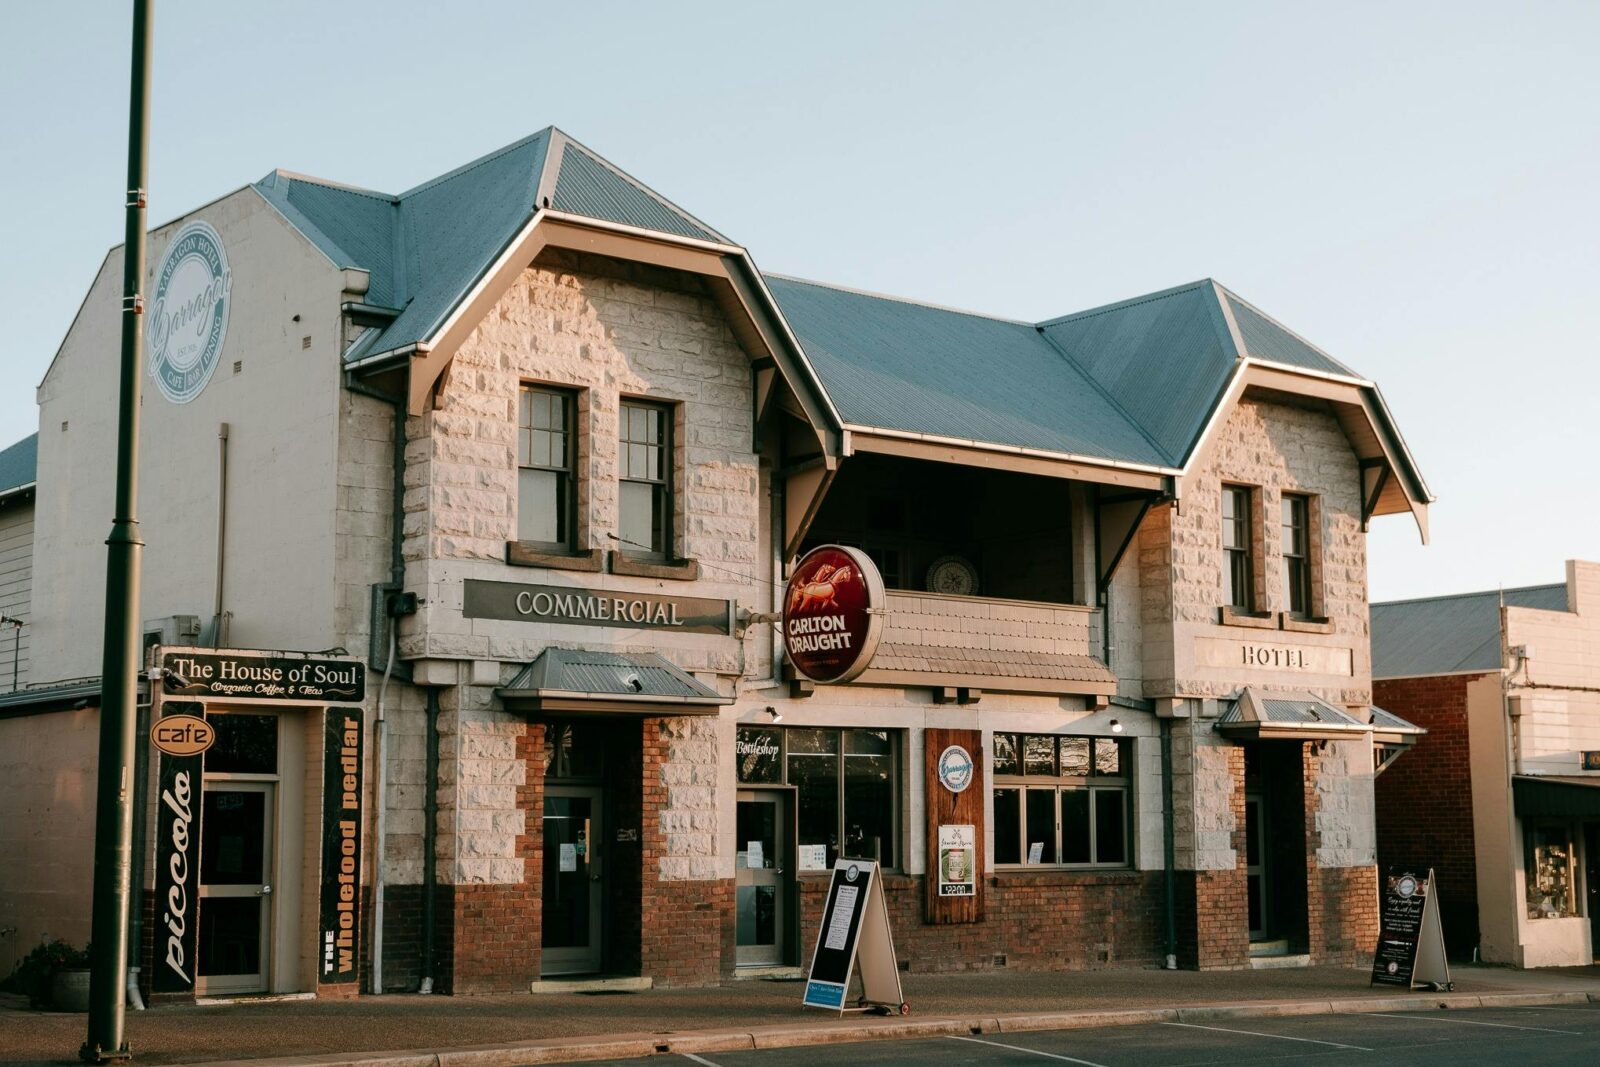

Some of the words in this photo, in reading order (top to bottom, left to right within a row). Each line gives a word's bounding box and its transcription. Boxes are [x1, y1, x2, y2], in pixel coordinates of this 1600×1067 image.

[159, 236, 197, 292] YARRAGON
[198, 238, 219, 273] HOTEL
[203, 317, 221, 366] DINING
[515, 591, 684, 627] COMMERCIAL
[789, 615, 846, 635] CARLTON
[790, 632, 852, 654] DRAUGHT
[1242, 646, 1310, 668] HOTEL
[173, 658, 213, 678] The
[220, 661, 283, 681] House
[288, 664, 312, 683] of
[314, 665, 357, 685] Soul
[210, 681, 253, 695] Organic
[254, 682, 285, 696] Coffee
[288, 685, 295, 694] &
[298, 686, 323, 695] Teas
[341, 717, 359, 810] pedlar
[736, 735, 779, 762] Bottleshop
[163, 770, 192, 984] piccolo
[337, 820, 356, 974] wholefood
[324, 930, 335, 976] THE
